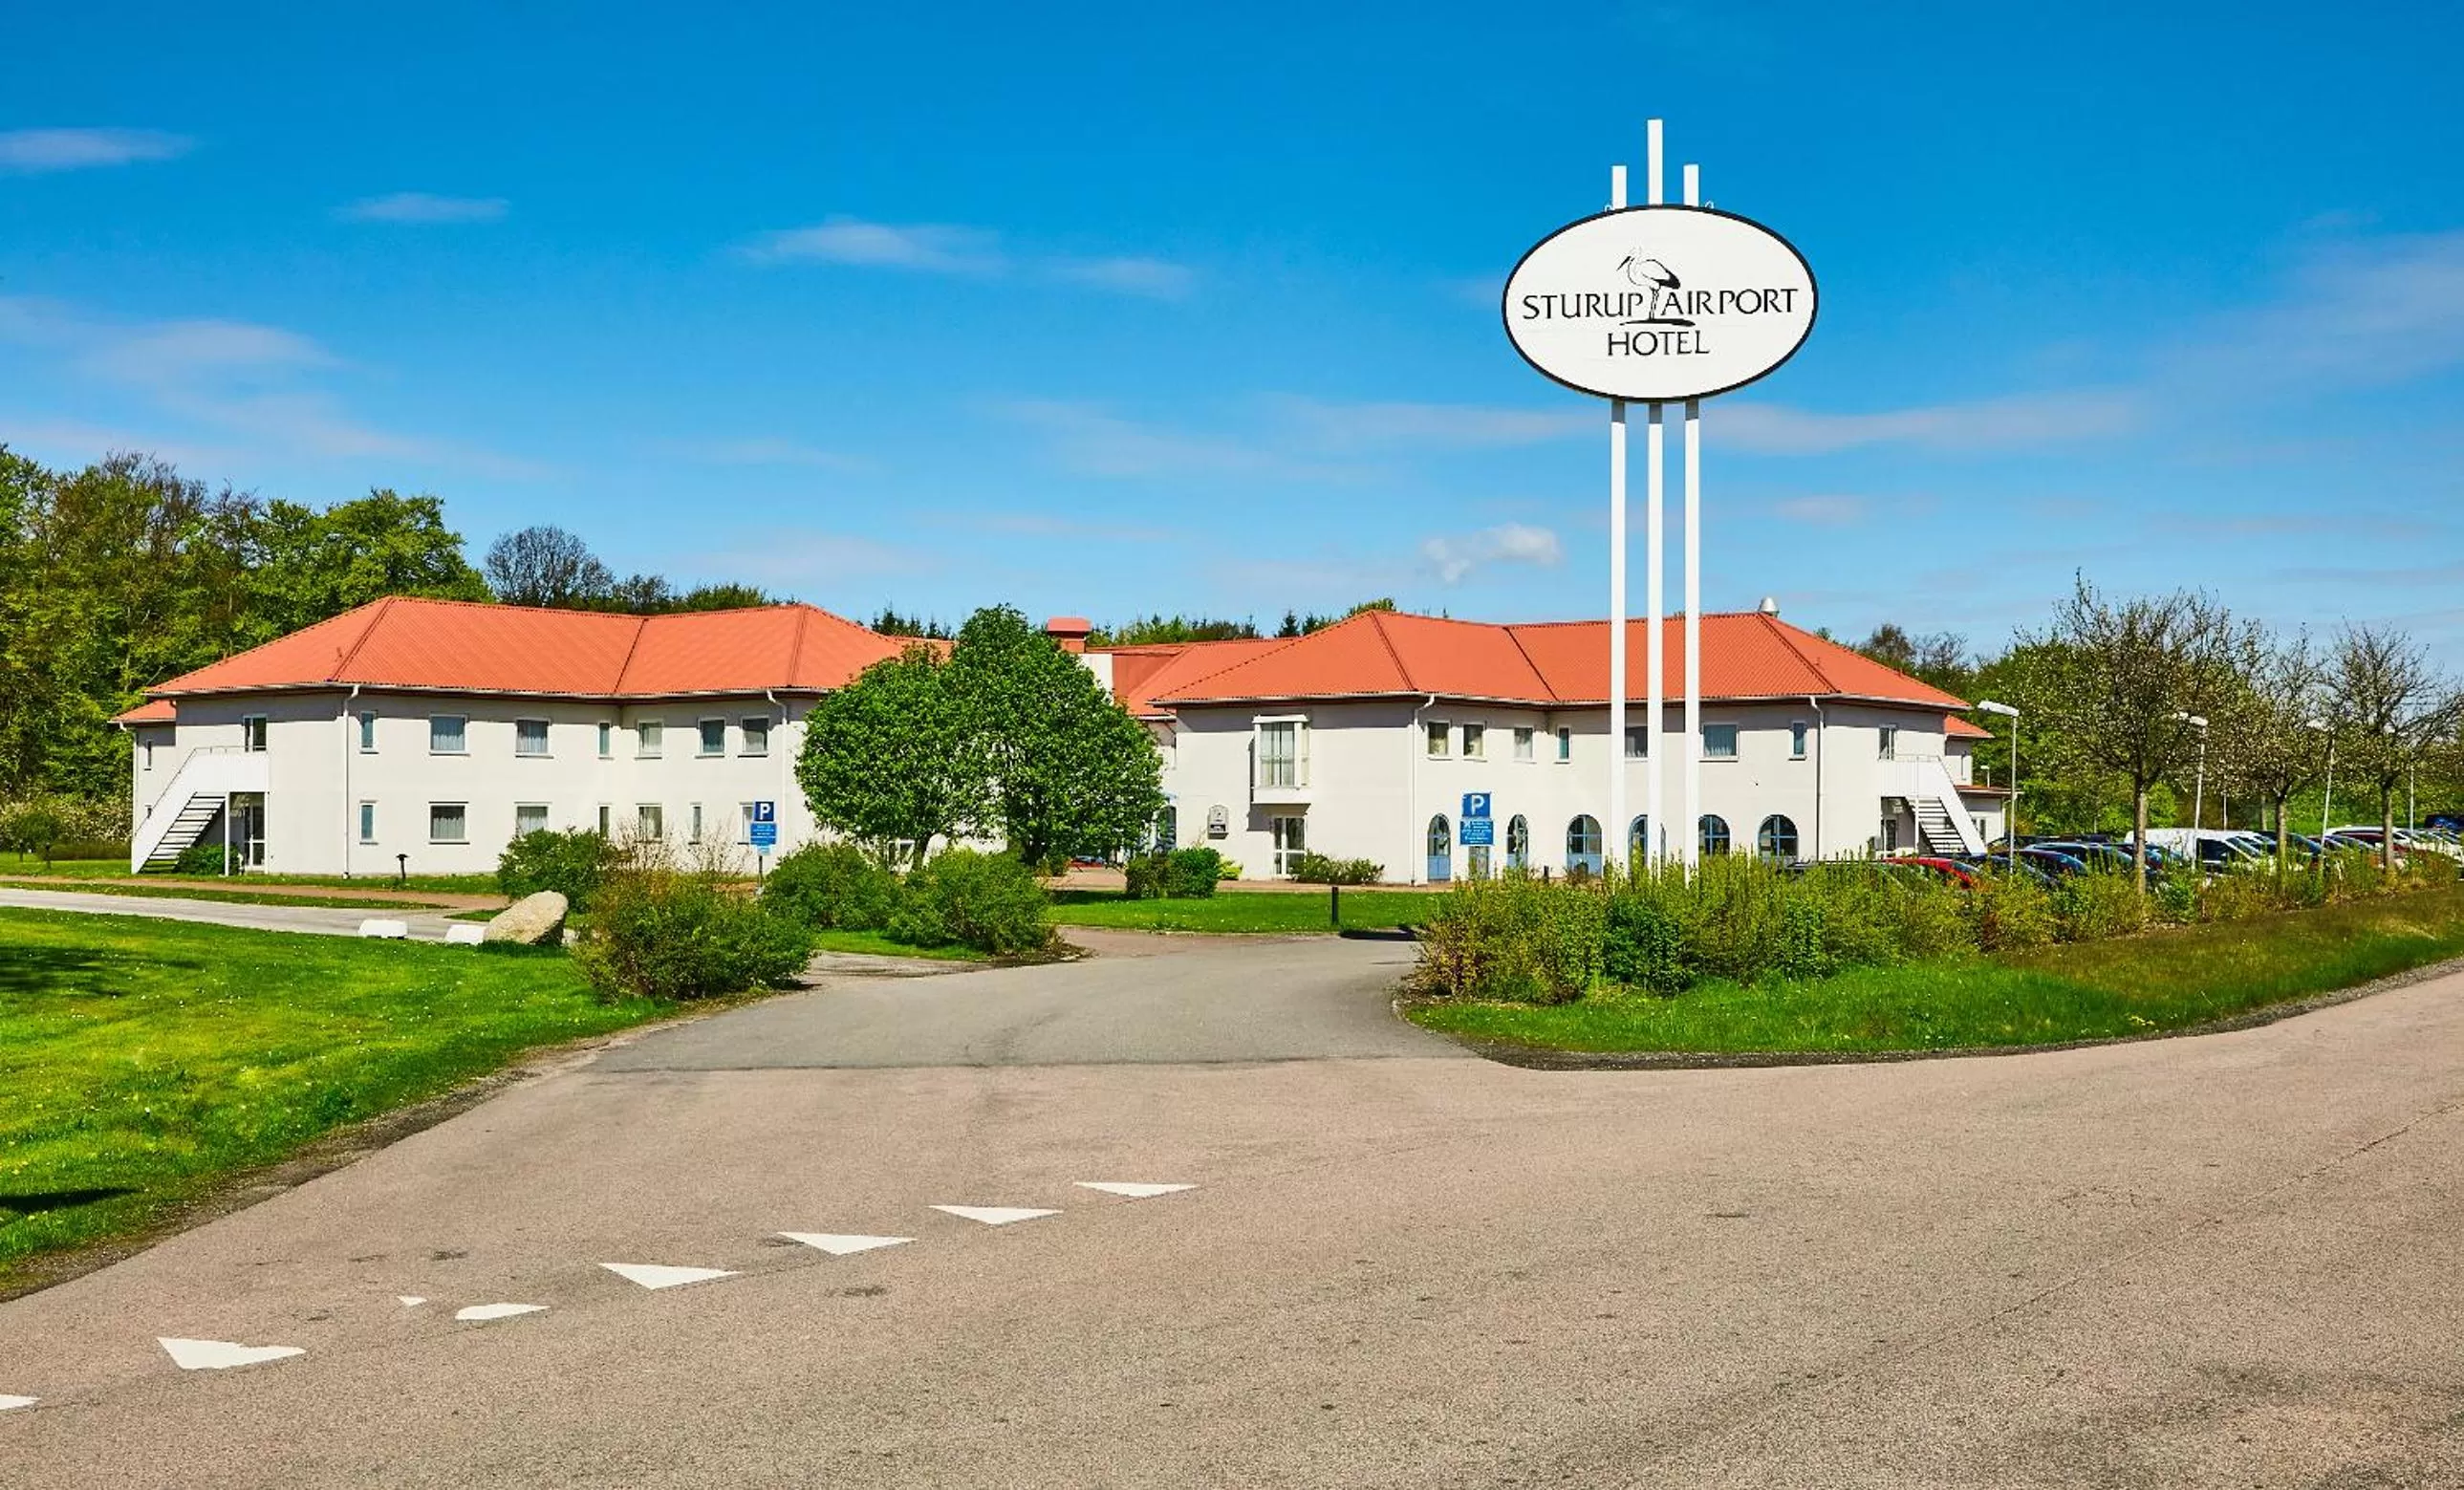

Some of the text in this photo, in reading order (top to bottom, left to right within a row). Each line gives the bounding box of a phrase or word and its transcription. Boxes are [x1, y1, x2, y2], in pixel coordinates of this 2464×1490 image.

[1523, 289, 1798, 319] STURUP AIRPORT
[1607, 330, 1710, 356] HOTEL
[760, 803, 770, 820] P
[1471, 794, 1484, 815] P
